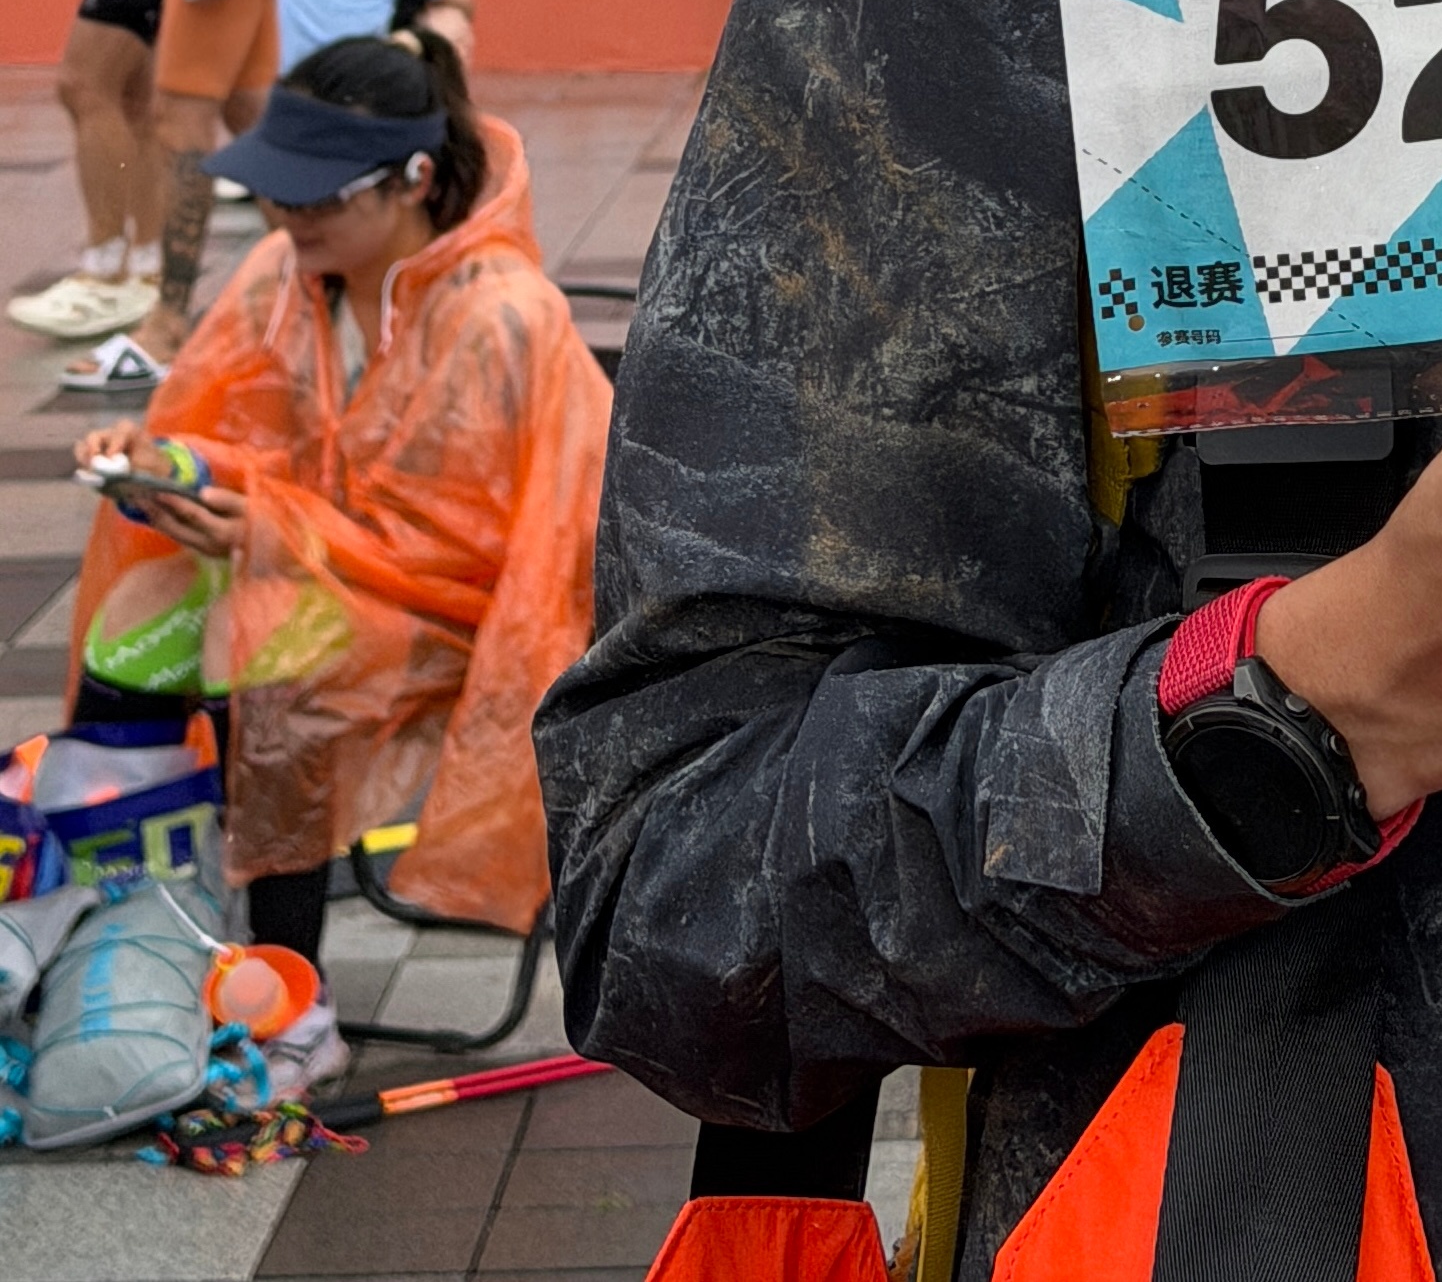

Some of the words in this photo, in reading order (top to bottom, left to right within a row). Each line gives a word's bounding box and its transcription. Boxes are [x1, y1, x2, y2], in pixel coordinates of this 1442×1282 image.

[1150, 261, 1245, 309] 退赛
[1156, 329, 1222, 348] 参赛号码
